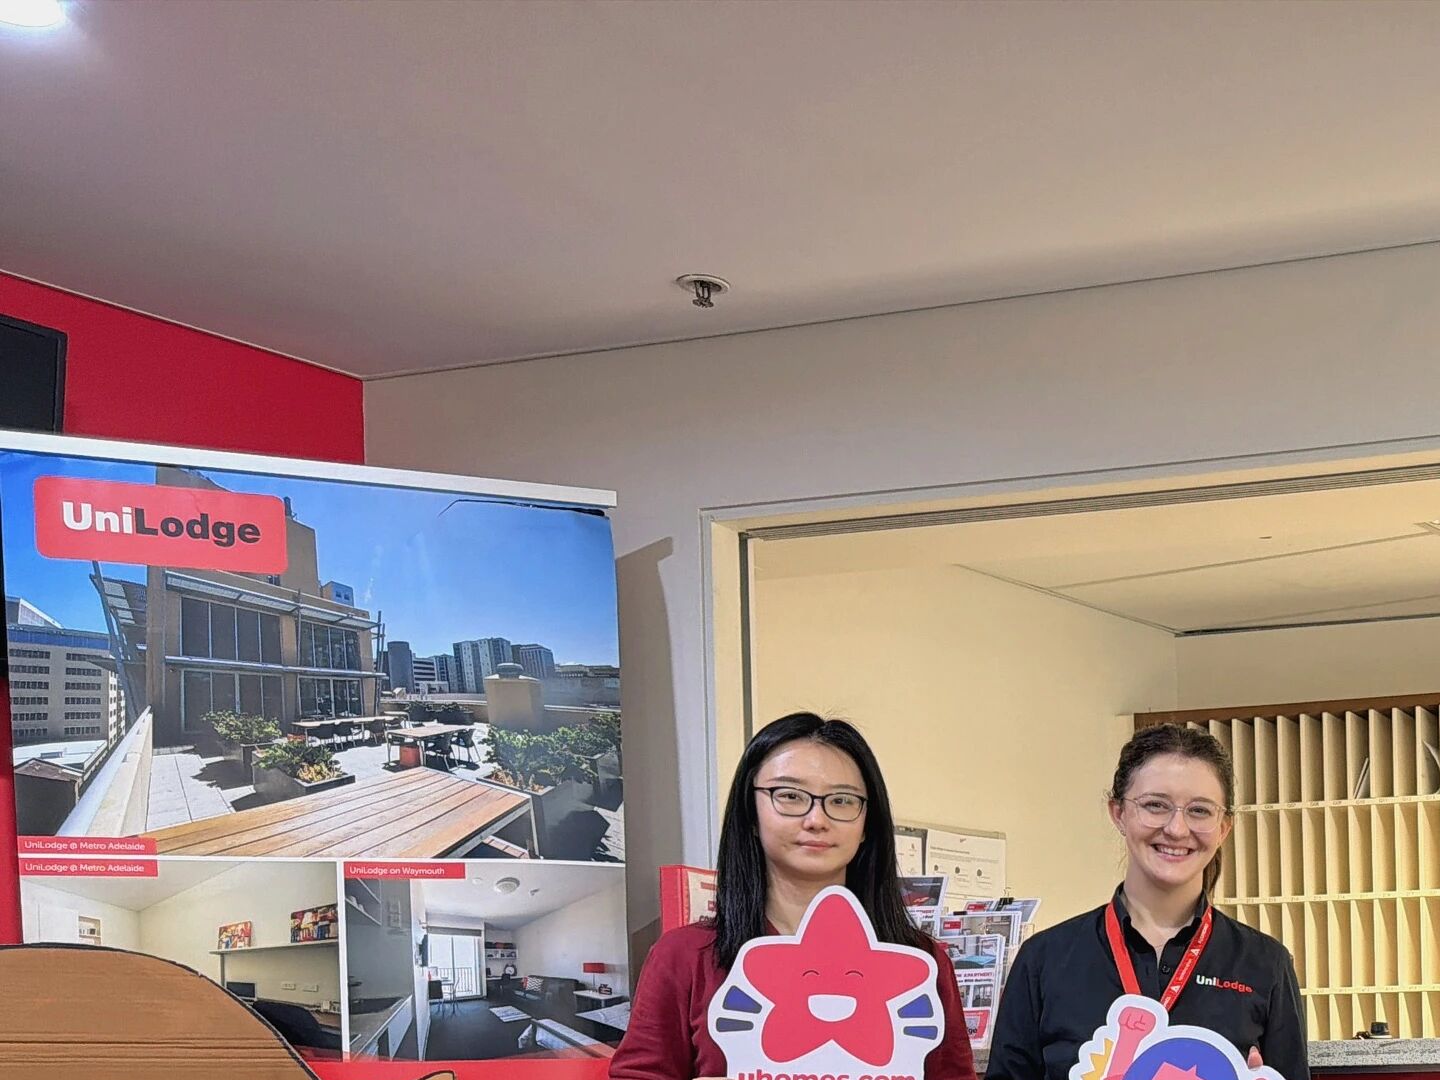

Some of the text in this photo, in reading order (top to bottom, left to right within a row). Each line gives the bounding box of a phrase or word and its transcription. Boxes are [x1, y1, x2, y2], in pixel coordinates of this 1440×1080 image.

[62, 501, 261, 547] UniLodge
[24, 841, 67, 850] UniLodge
[80, 842, 106, 850] Metro
[108, 842, 145, 850] Adelaide
[25, 863, 68, 872] UniLodge
[80, 864, 106, 872] Metro
[107, 864, 145, 872] Adelaide
[350, 866, 388, 876] UniLodge
[402, 867, 445, 876] Waymouth
[1196, 974, 1253, 992] UniLodge
